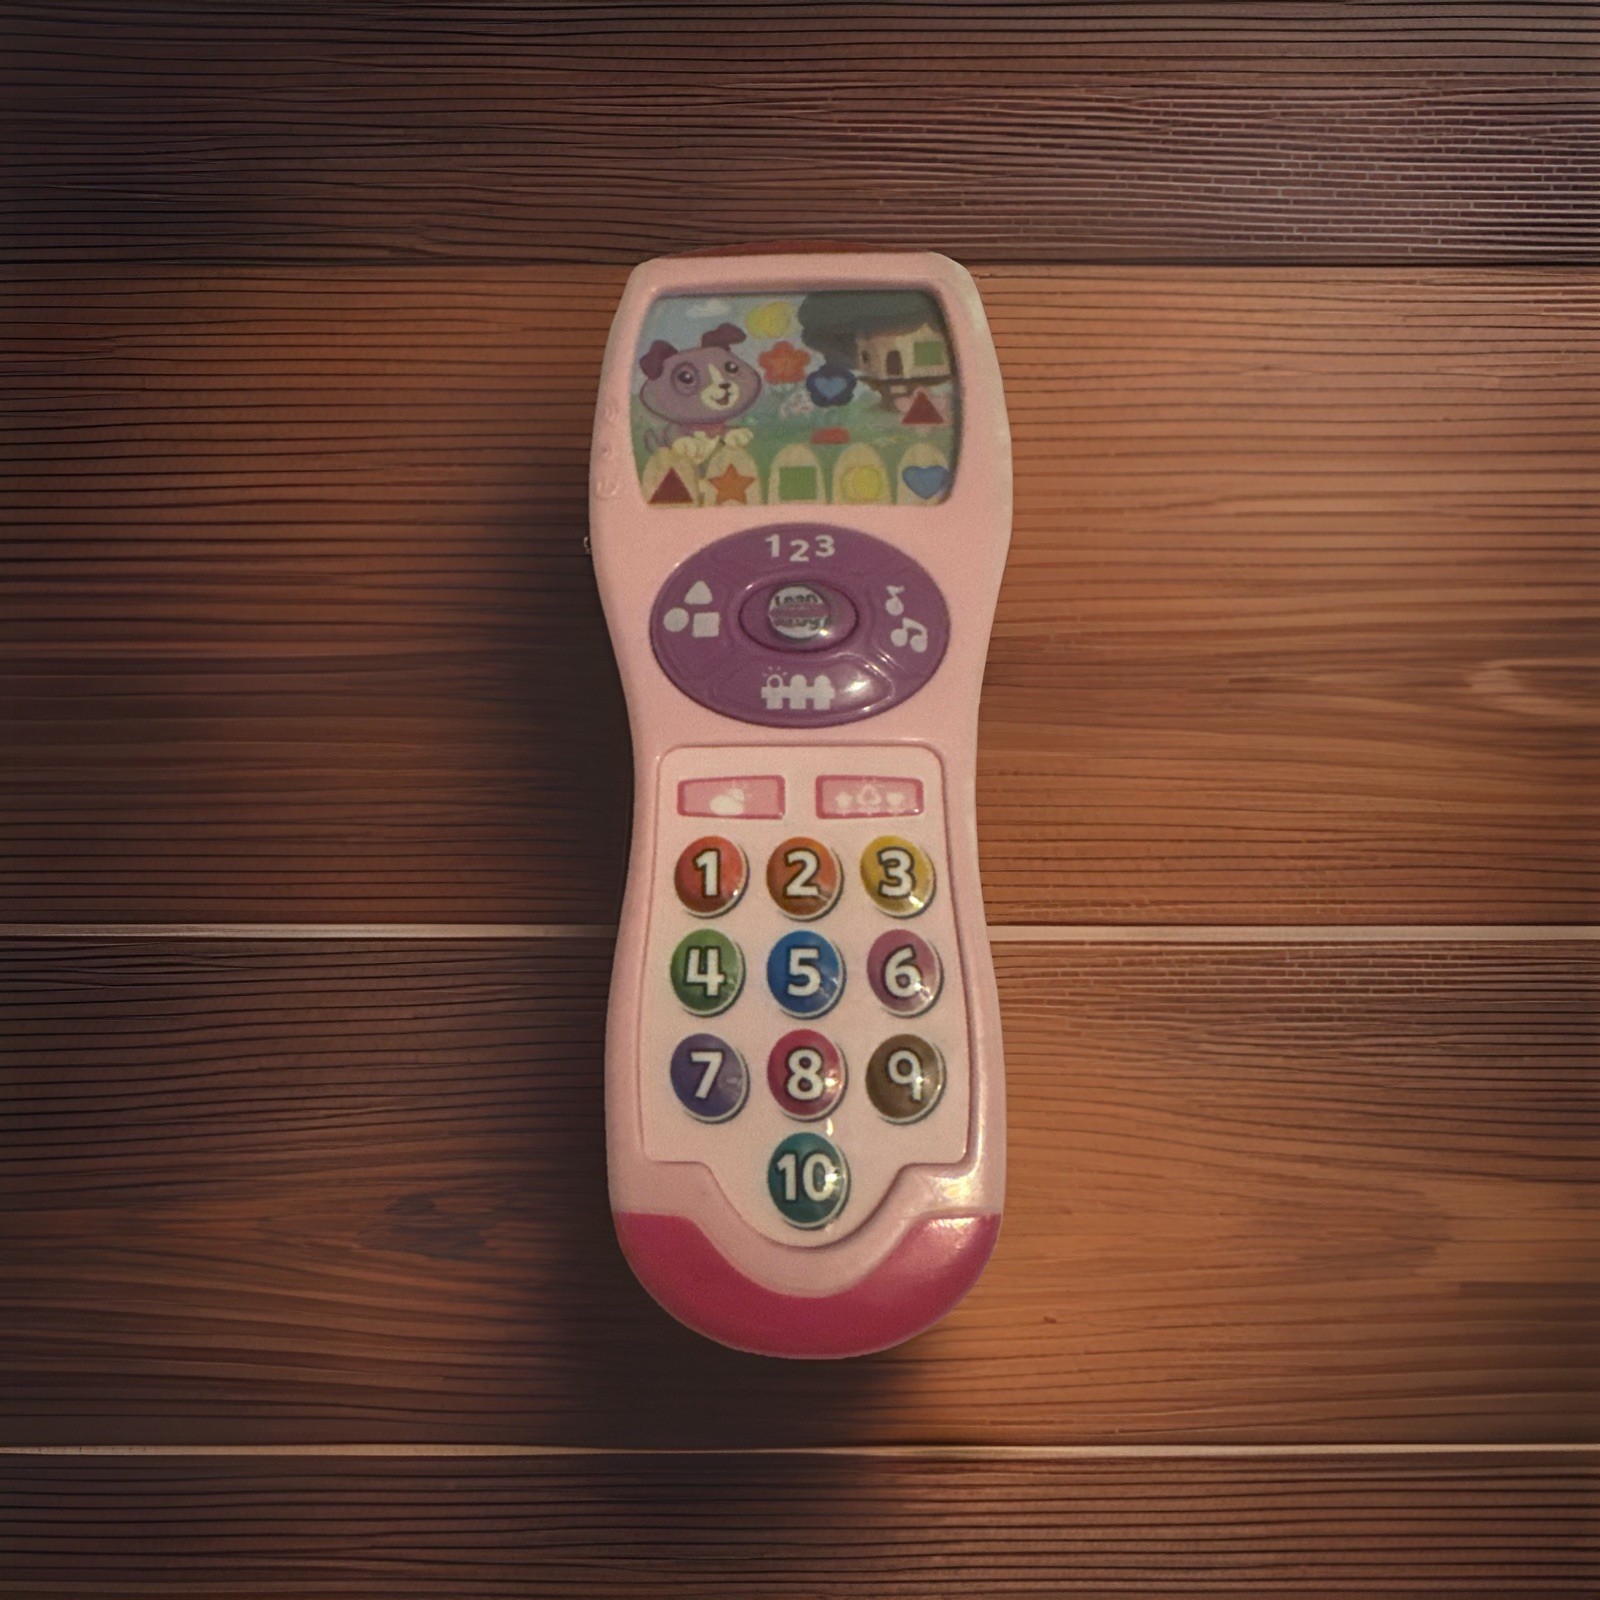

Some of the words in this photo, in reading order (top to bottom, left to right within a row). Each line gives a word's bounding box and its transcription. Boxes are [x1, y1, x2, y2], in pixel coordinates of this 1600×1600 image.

[694, 849, 721, 897] 1
[785, 849, 820, 897] 2
[878, 848, 914, 897] 3
[684, 947, 726, 998] 4
[786, 946, 822, 998] 5
[883, 945, 921, 999] 6
[689, 1050, 724, 1100] 7
[786, 1047, 824, 1101] 8
[887, 1048, 922, 1102] 9
[775, 1151, 837, 1202] 10
